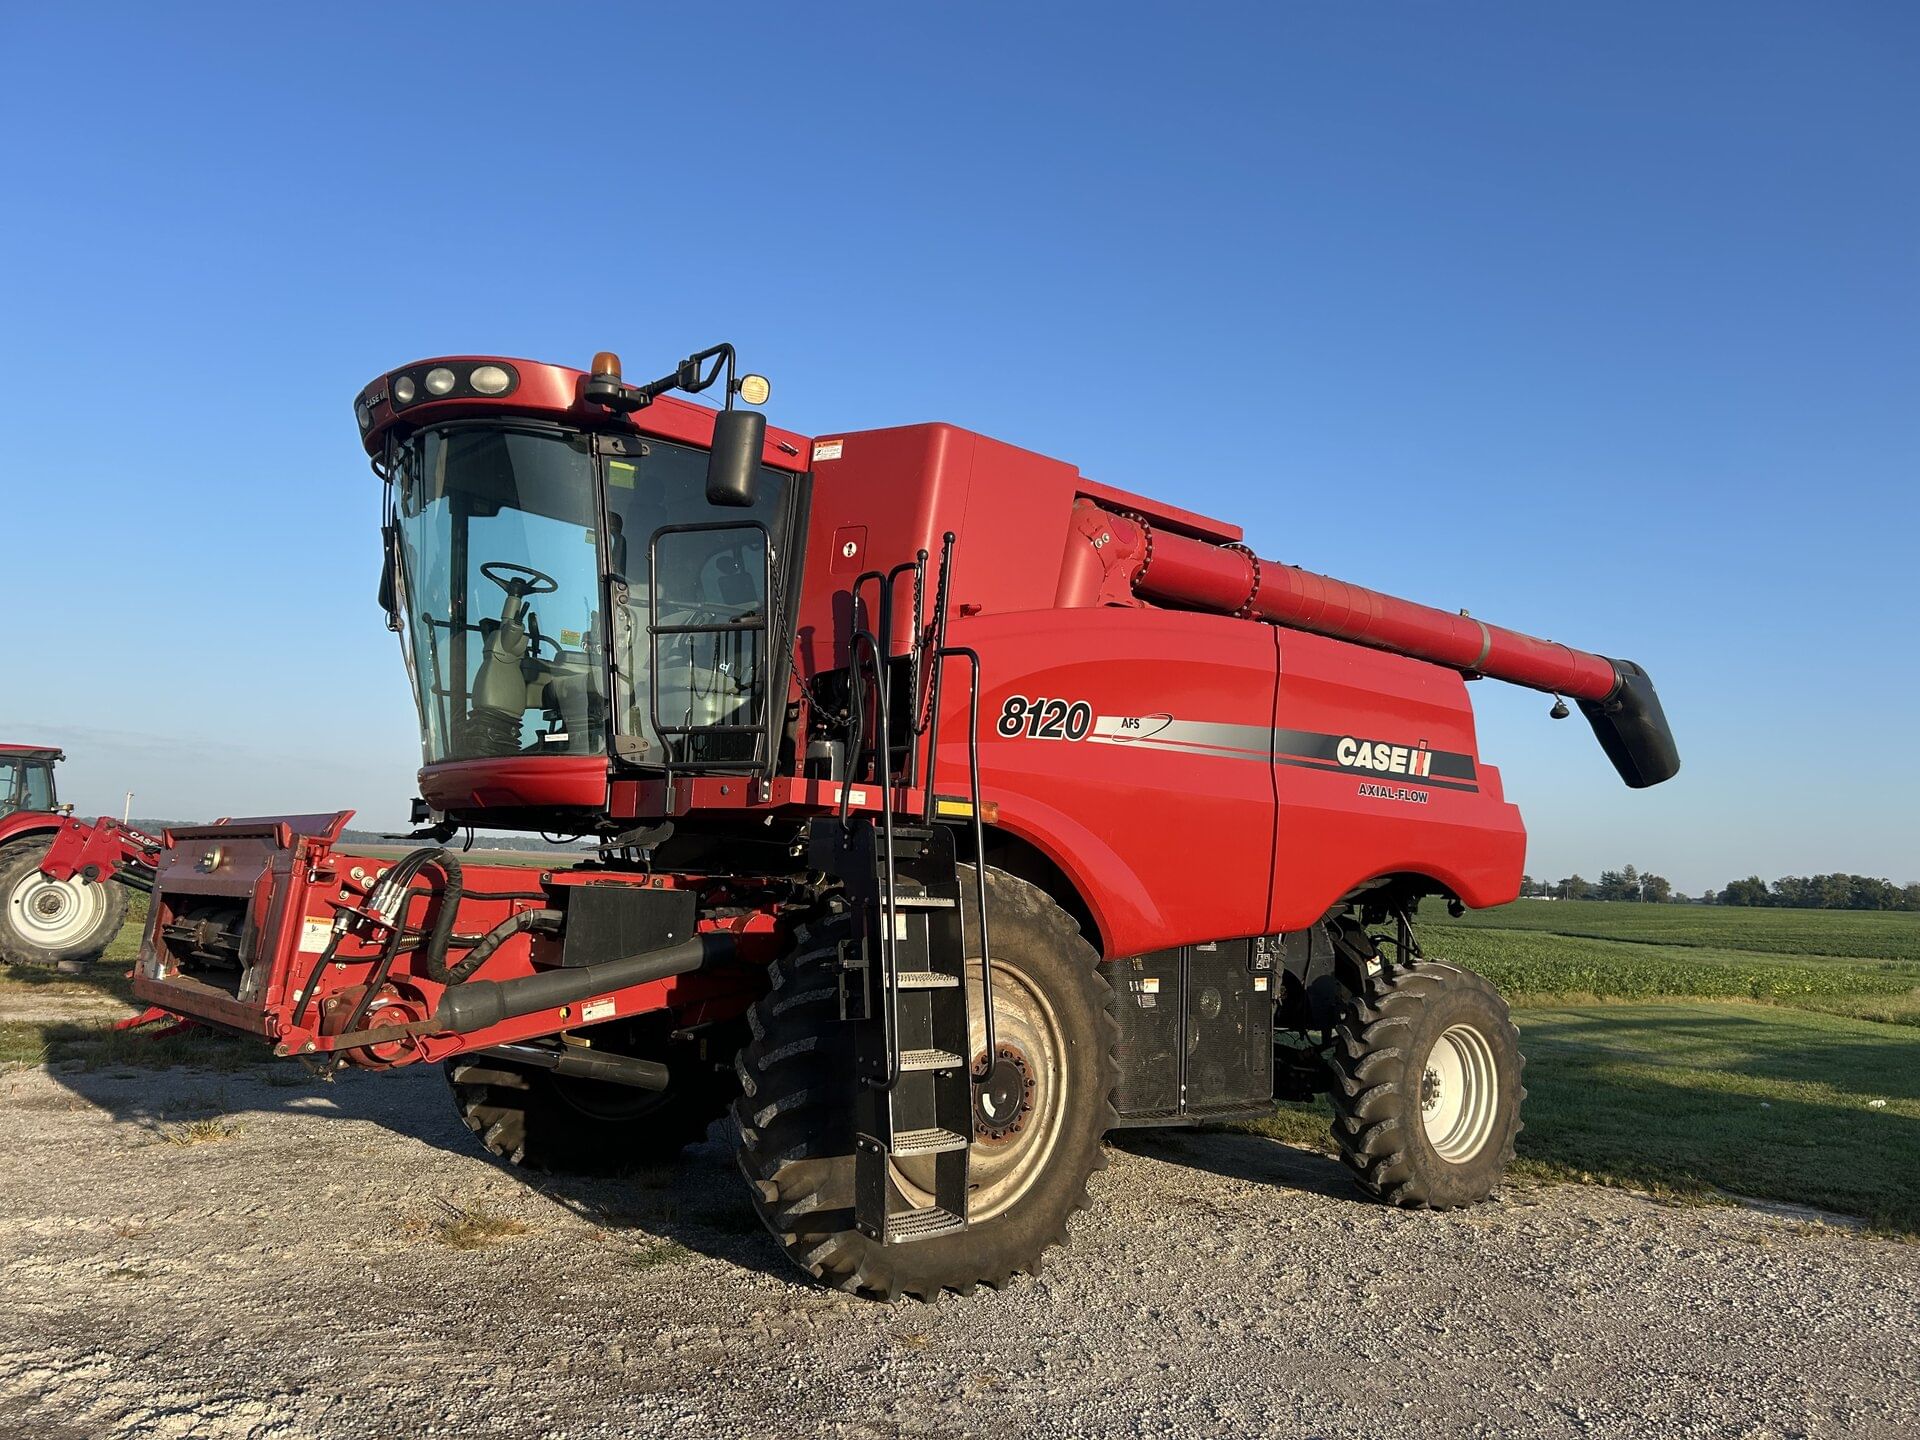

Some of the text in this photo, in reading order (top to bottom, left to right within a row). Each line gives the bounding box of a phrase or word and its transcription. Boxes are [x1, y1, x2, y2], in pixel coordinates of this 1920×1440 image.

[998, 696, 1091, 741] 8120
[1121, 717, 1140, 729] AFS
[1336, 738, 1408, 773] CASE
[1359, 783, 1428, 803] AXIAL-FLOW
